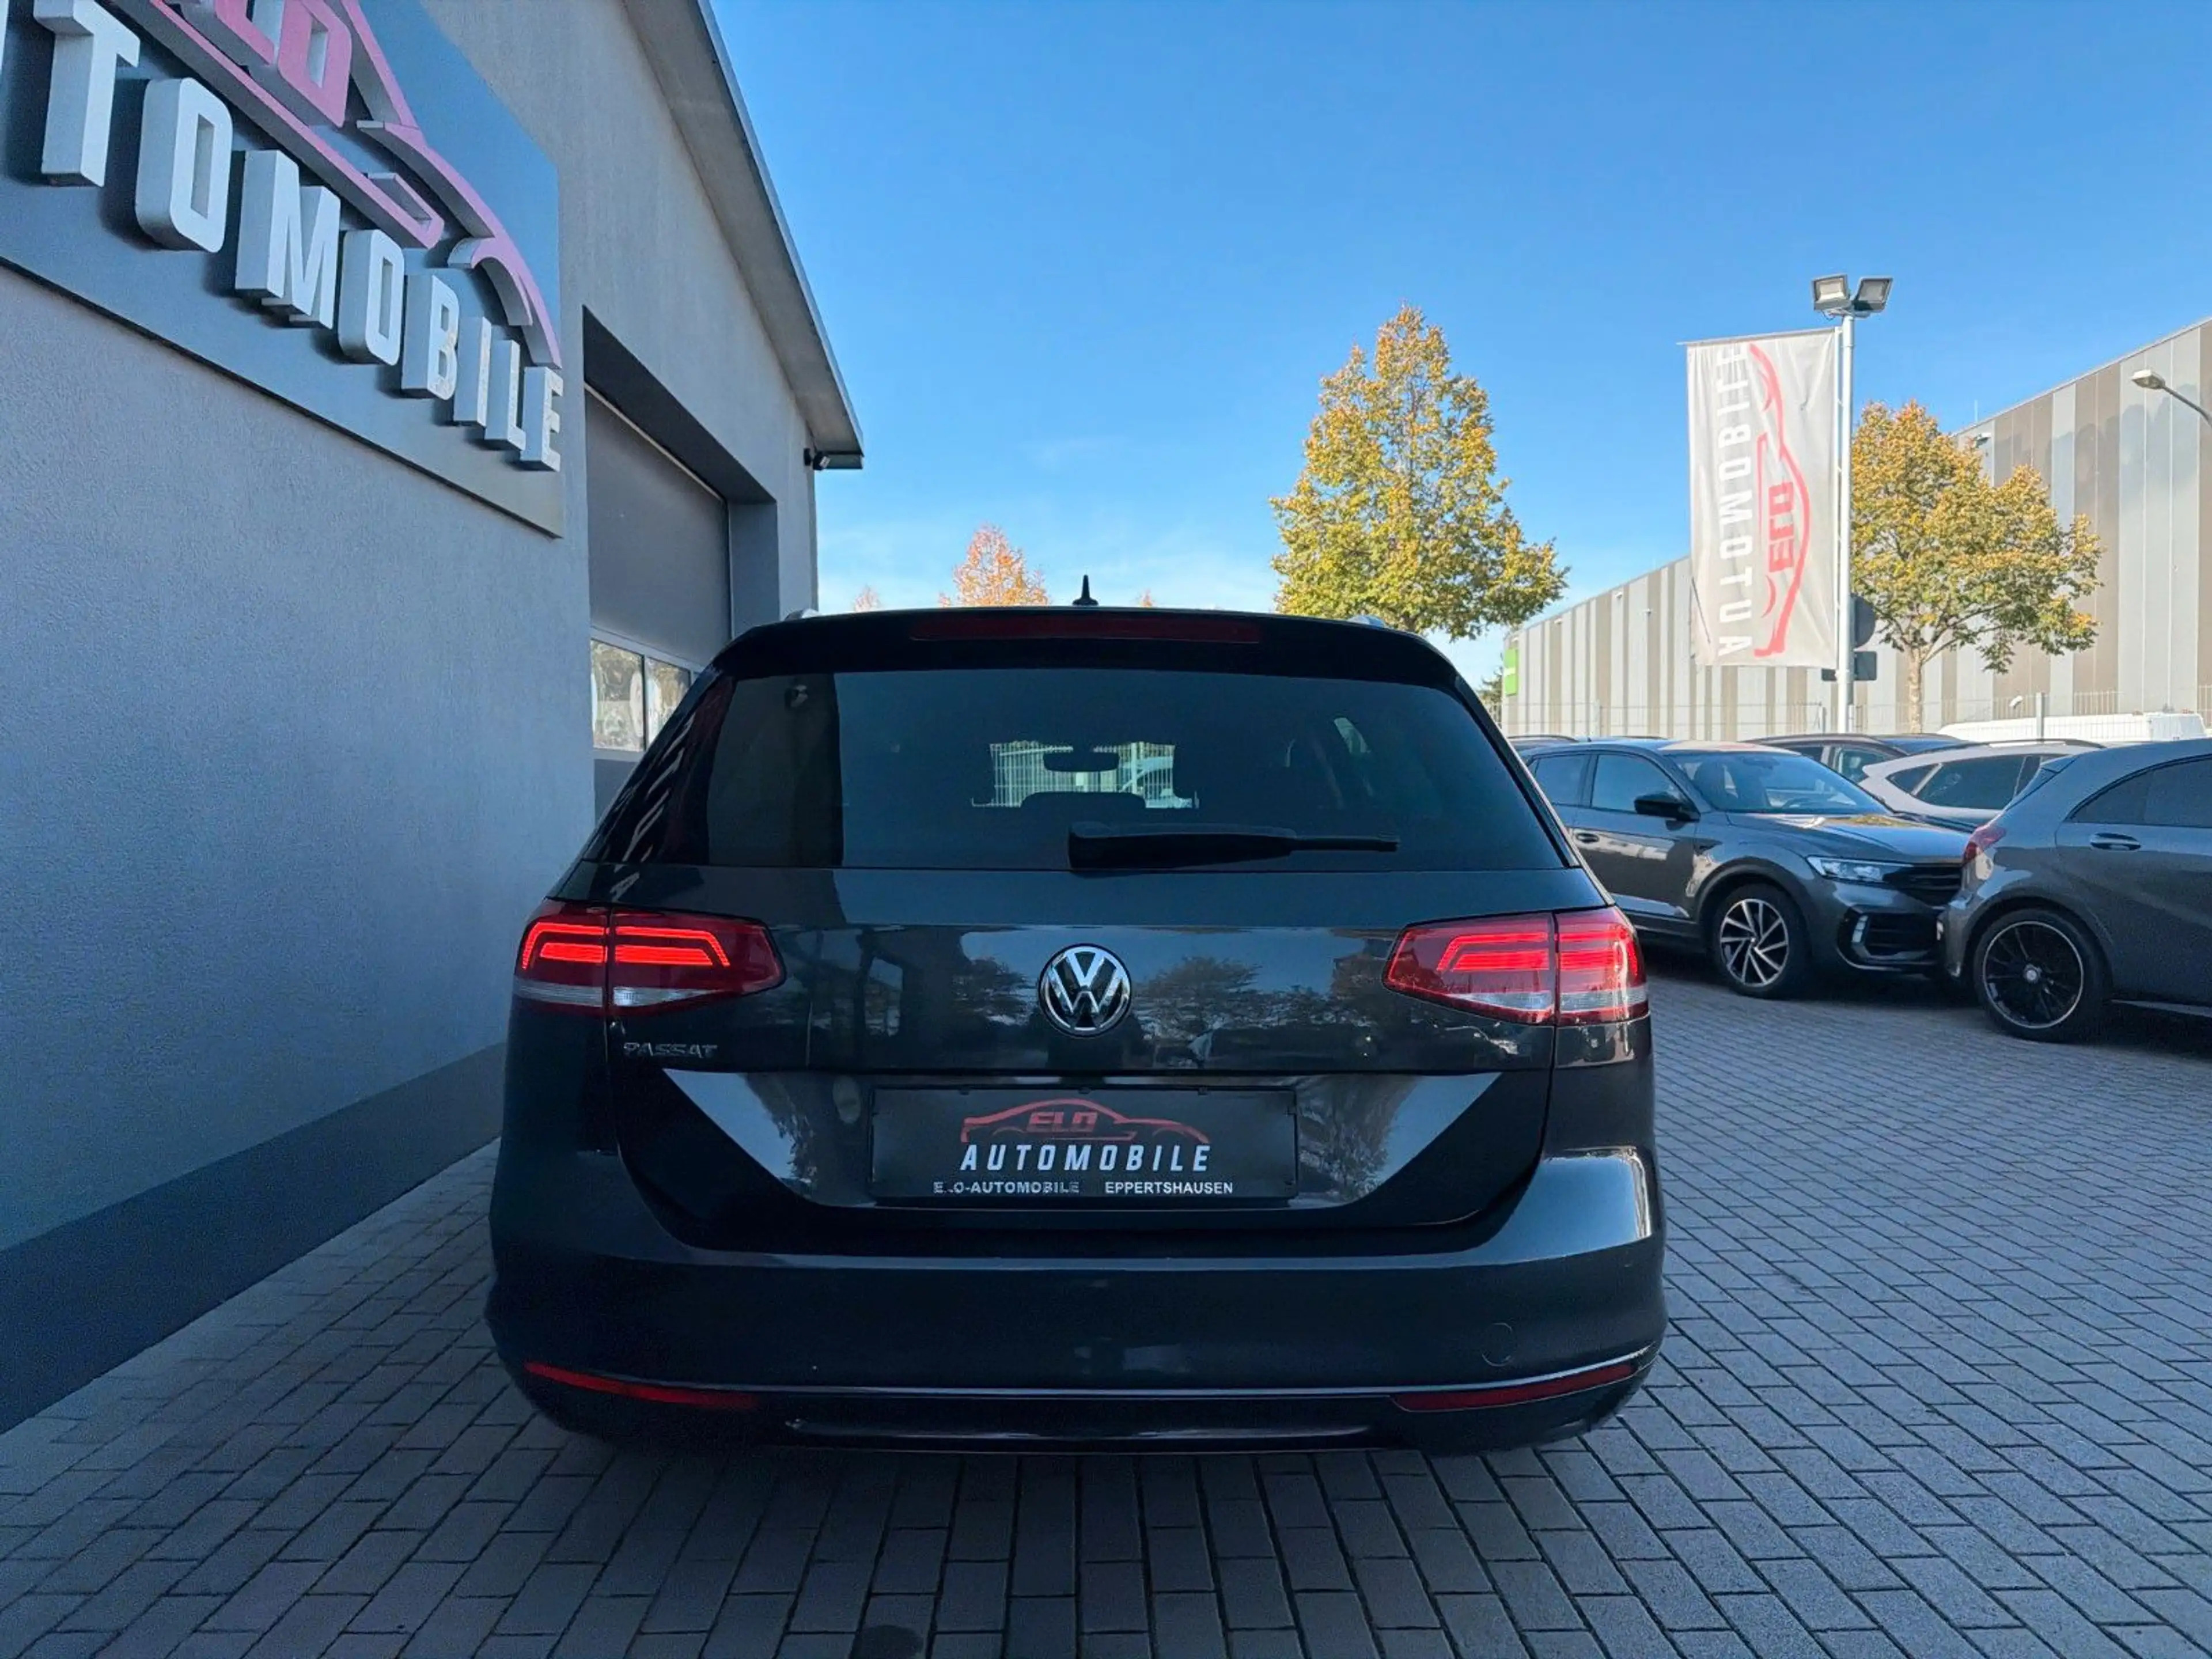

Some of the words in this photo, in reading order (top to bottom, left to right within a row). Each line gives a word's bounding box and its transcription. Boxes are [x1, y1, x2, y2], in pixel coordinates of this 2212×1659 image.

[0, 0, 563, 471] TOMOBILE
[623, 1041, 718, 1059] PASSAT
[960, 1145, 1210, 1171] AUTOMOBILE
[933, 1181, 1080, 1194] EO-AUTOMOBILE
[1105, 1181, 1233, 1194] EPPERTSHAUSEN
